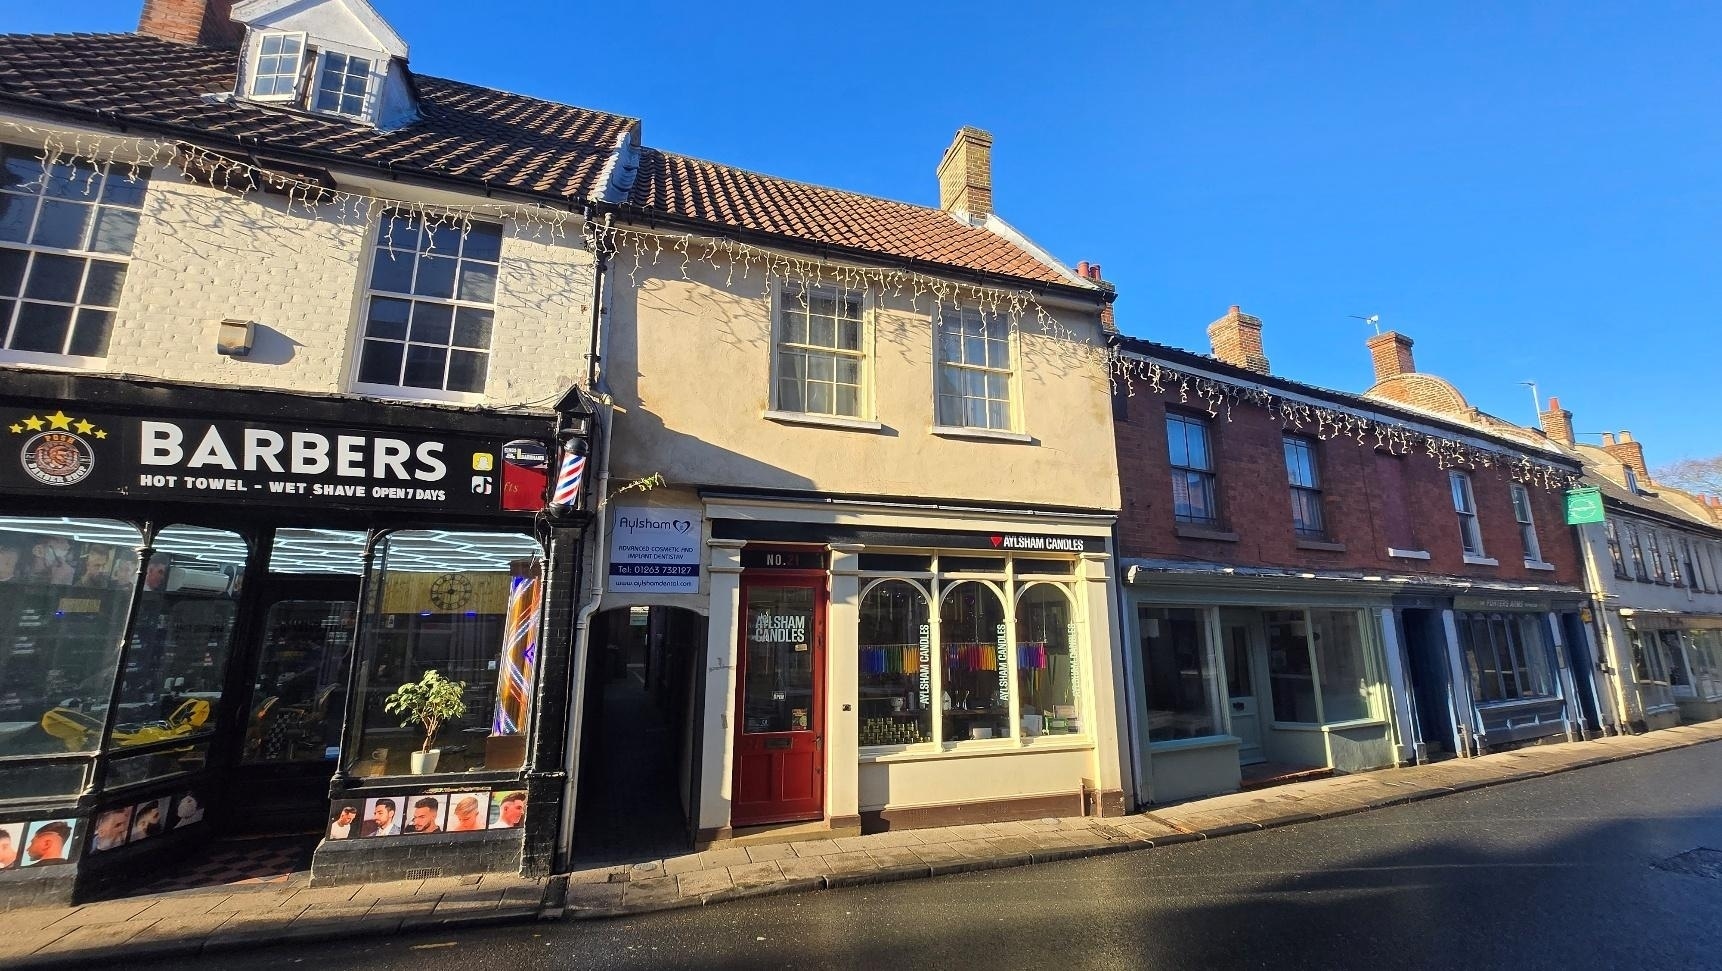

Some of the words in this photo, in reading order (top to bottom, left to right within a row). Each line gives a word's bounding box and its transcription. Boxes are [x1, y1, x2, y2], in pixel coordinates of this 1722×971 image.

[140, 420, 447, 482] BARBERS
[28, 463, 64, 482] BARBER
[65, 465, 87, 481] SHOP
[140, 474, 178, 488] HOT
[184, 476, 248, 491] TOWEL
[268, 481, 307, 494] WET
[312, 483, 366, 497] SHAVE
[372, 486, 405, 499] OPEN
[406, 488, 414, 499] 7
[415, 488, 446, 501] DAYS
[619, 516, 671, 534] Aylsham
[1003, 535, 1044, 549] AYLSHAM
[1046, 537, 1084, 551] CANDLES
[618, 565, 632, 574] Tel:
[634, 566, 660, 574] 01263
[615, 580, 692, 588] www.aylshamdental.com
[755, 615, 806, 629] AYLSHAM
[755, 628, 805, 643] CANDLES
[919, 624, 930, 663] CANDLES
[996, 624, 1007, 661] CANDLES
[919, 664, 930, 705] AYLSHAM
[999, 662, 1009, 701] AYLSHAM
